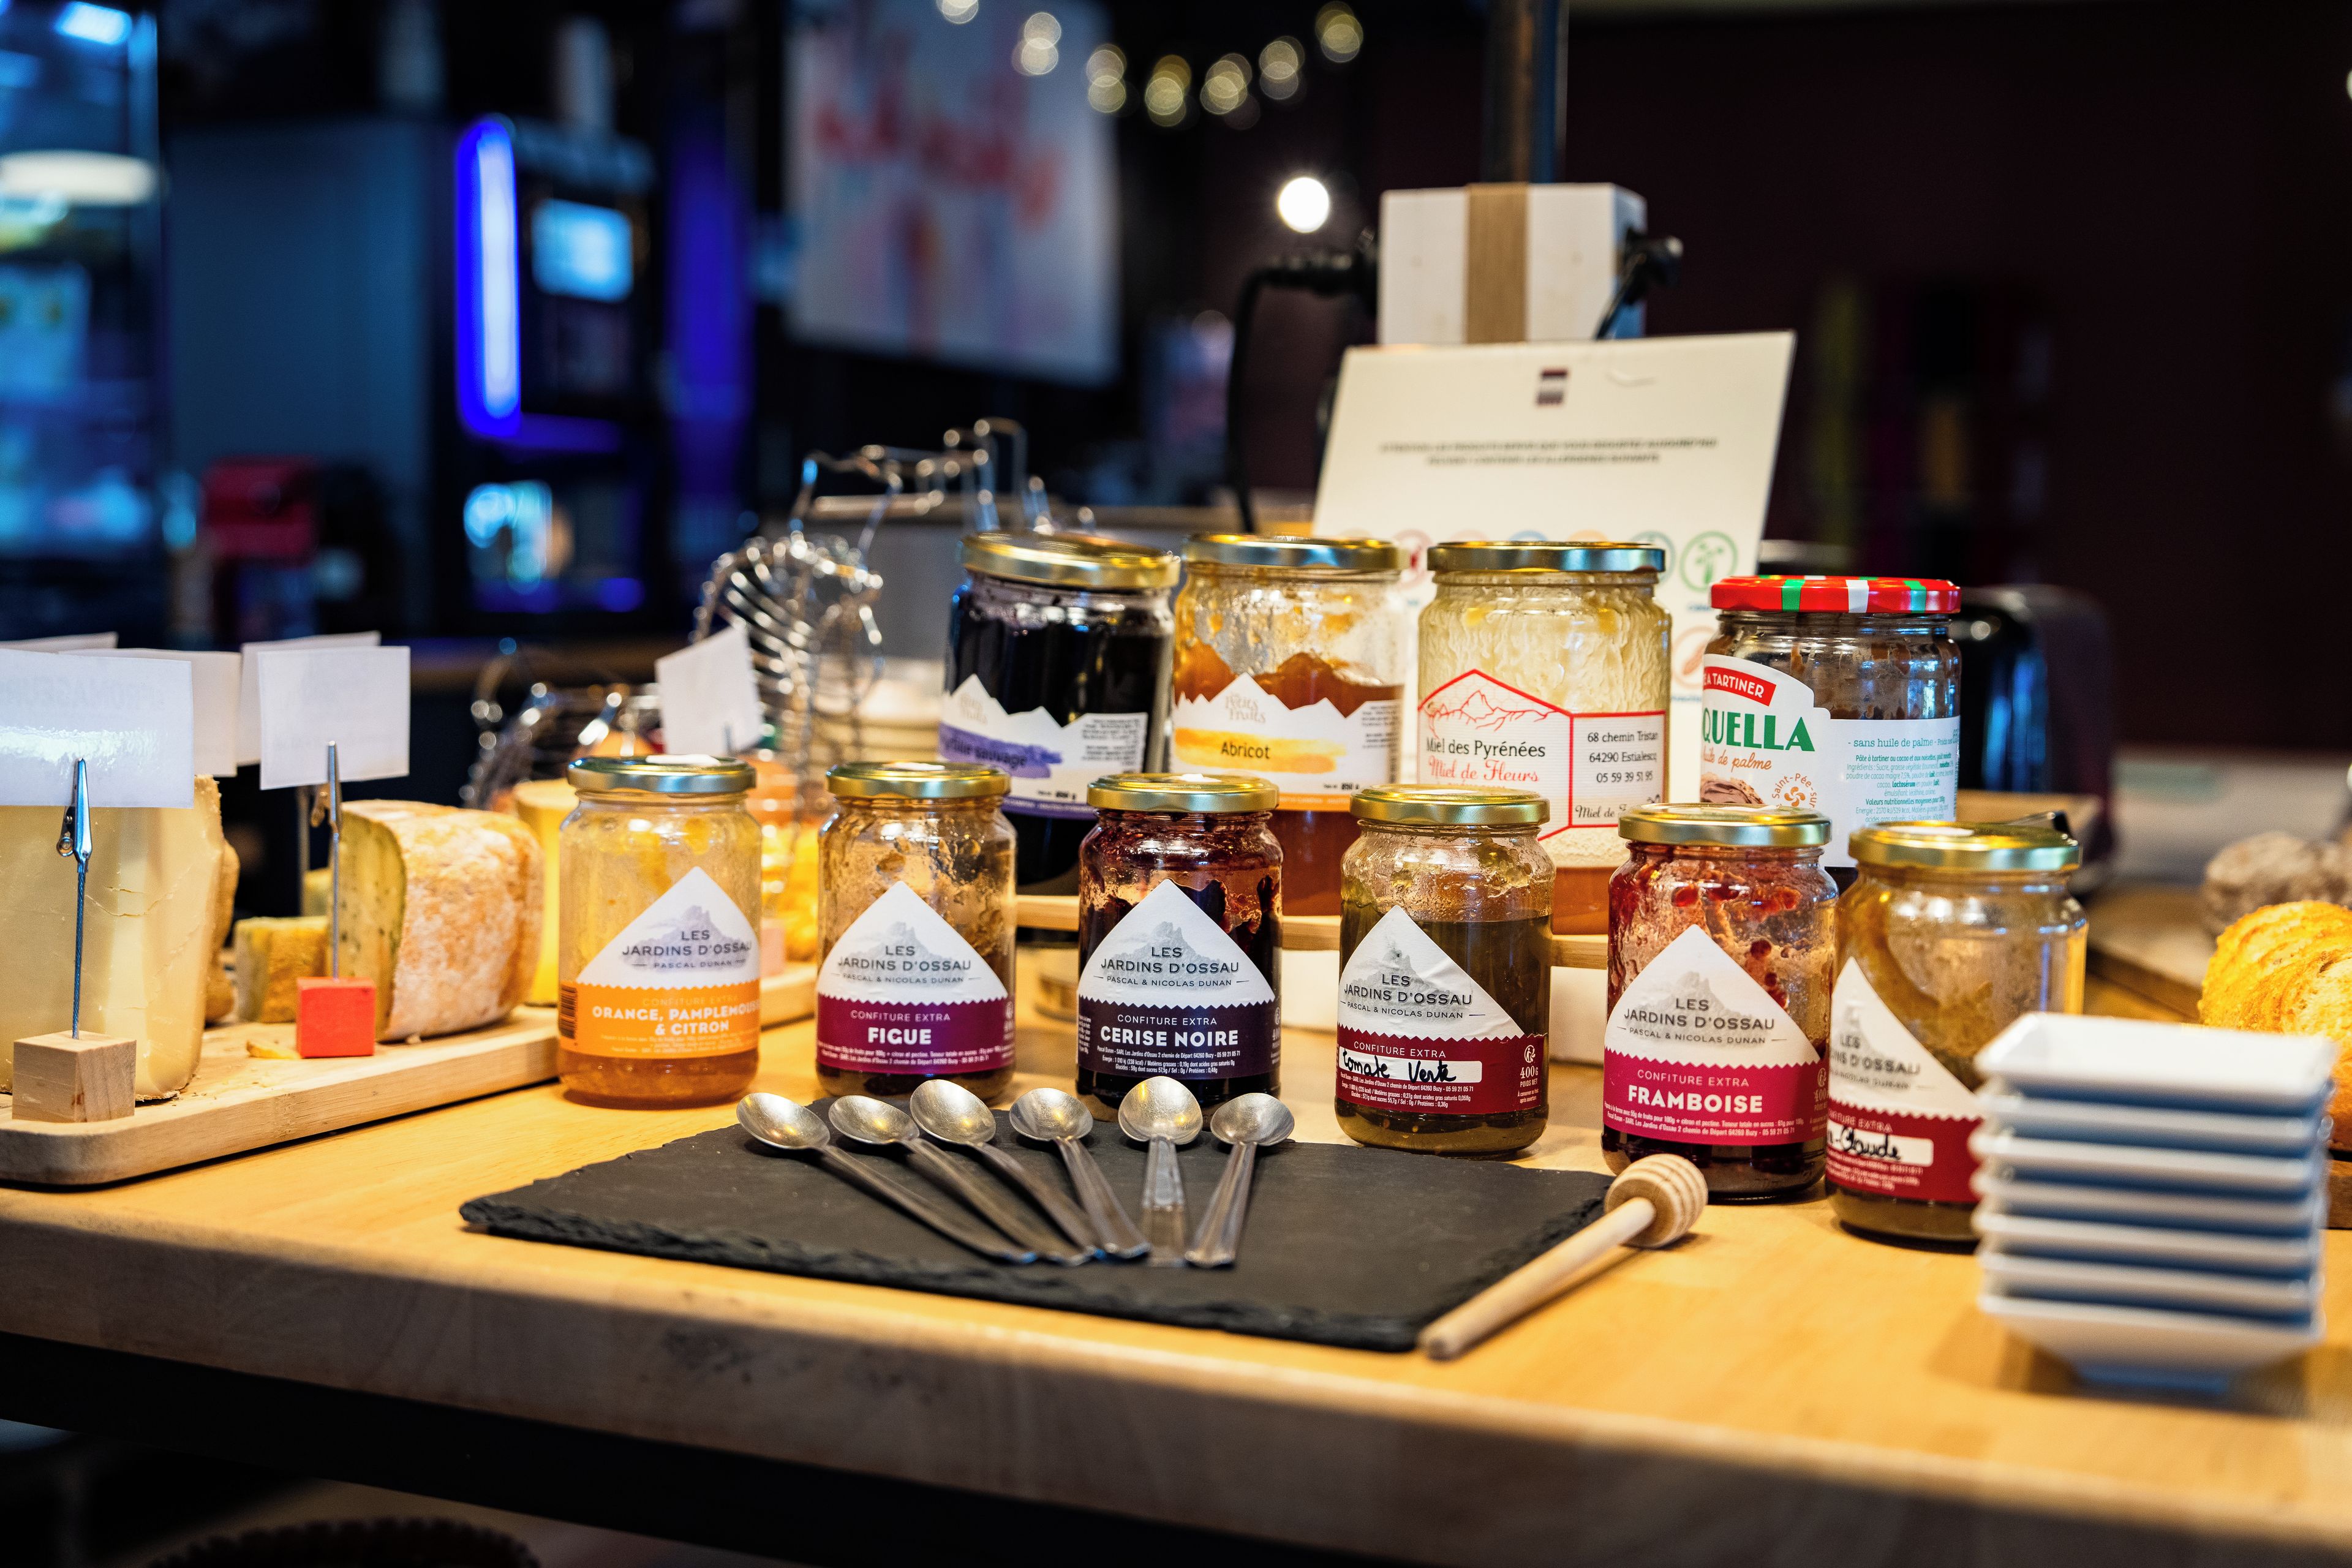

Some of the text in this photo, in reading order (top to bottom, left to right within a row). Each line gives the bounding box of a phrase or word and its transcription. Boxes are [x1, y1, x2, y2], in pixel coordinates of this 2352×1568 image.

[1712, 673, 1764, 698] TARTINER
[1588, 732, 1599, 742] 68
[1602, 732, 1634, 742] chemin
[1877, 739, 1899, 747] huile
[1912, 738, 1932, 748] palme
[1221, 742, 1271, 760] Abricot
[1427, 737, 1545, 760] Miel des Pyrénées
[1589, 752, 1619, 763] 64290
[1718, 750, 1728, 766] de
[1731, 752, 1772, 772] palme
[1428, 755, 1539, 782] Miel de Fleurs
[1596, 772, 1608, 783] 05
[1611, 772, 1622, 782] 59
[1624, 772, 1634, 782] 39
[1575, 805, 1615, 818] Miel de
[681, 930, 710, 941] LES
[622, 945, 692, 956] JARDINS
[886, 946, 915, 956] LES
[1152, 946, 1182, 958] LES
[838, 957, 971, 971] JARDINS D'OSSAU
[1101, 959, 1240, 974] JARDINS D'OSSAU
[843, 973, 873, 982] PASCAL
[1107, 976, 1138, 985] PASCAL
[1382, 974, 1411, 987] LES
[643, 997, 704, 1006] CONFITURE
[1344, 984, 1472, 1005] JARDINS D'OSSAU
[1348, 1003, 1371, 1012] PASCAL
[1382, 1008, 1422, 1017] NICOLAS
[1676, 998, 1709, 1011] LES
[592, 1006, 663, 1022] ORANGE,
[850, 1009, 951, 1022] CONFITURE EXTRA
[1117, 1014, 1177, 1025] CONFITURE
[1624, 1009, 1774, 1030] JARDINS D'OSSAU
[655, 1020, 729, 1035] & CITRON
[1629, 1027, 1661, 1039] PASCAL
[1675, 1034, 1722, 1043] NICOLAS
[868, 1027, 932, 1045] FIGUE
[1101, 1026, 1167, 1046] CERISE
[1175, 1030, 1238, 1047] NOIRE
[1840, 1034, 1861, 1049] LES
[1354, 1041, 1446, 1058] CONFITURE EXTRA
[1408, 1060, 1457, 1083] Verte
[1637, 1069, 1749, 1087] CONFITURE EXTRA
[1628, 1084, 1763, 1114] FRAMBOISE
[1858, 1118, 1893, 1133] EXTRA
